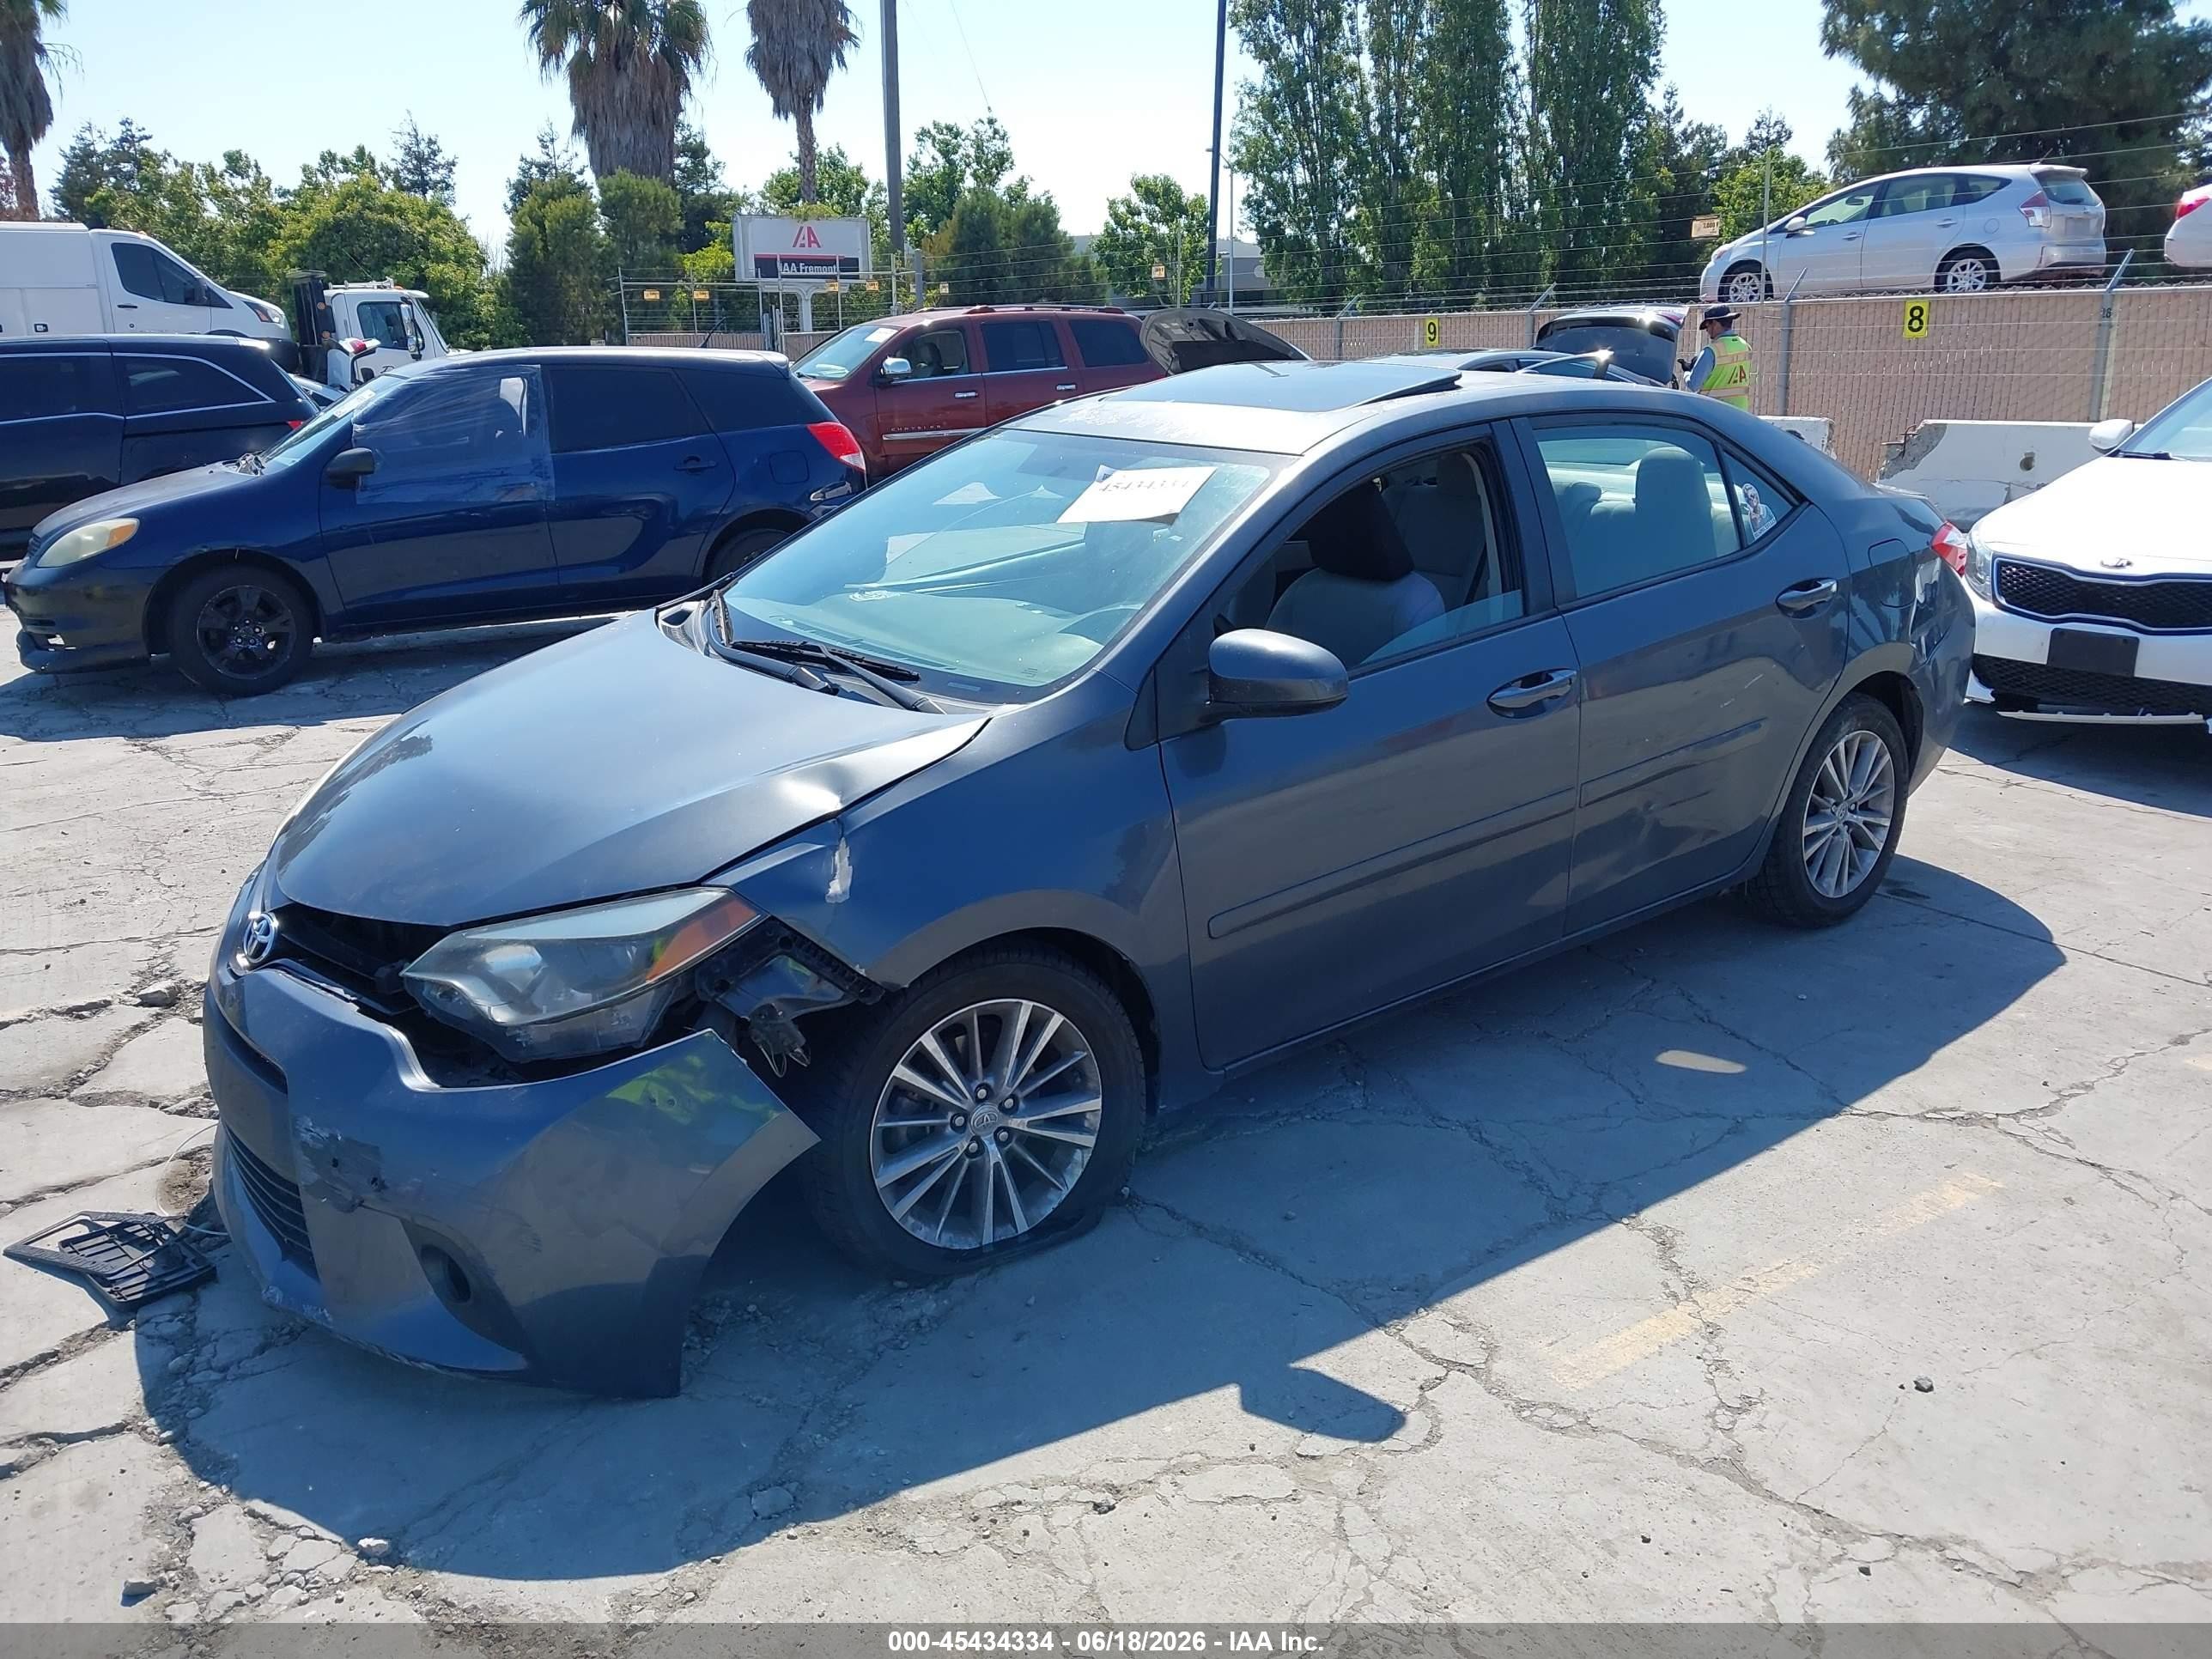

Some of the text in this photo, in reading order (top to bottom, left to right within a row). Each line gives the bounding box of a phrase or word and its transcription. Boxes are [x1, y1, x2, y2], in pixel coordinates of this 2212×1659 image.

[780, 262, 836, 273] IAA Fremont
[1907, 305, 1924, 333] 8
[1427, 321, 1437, 343] 9
